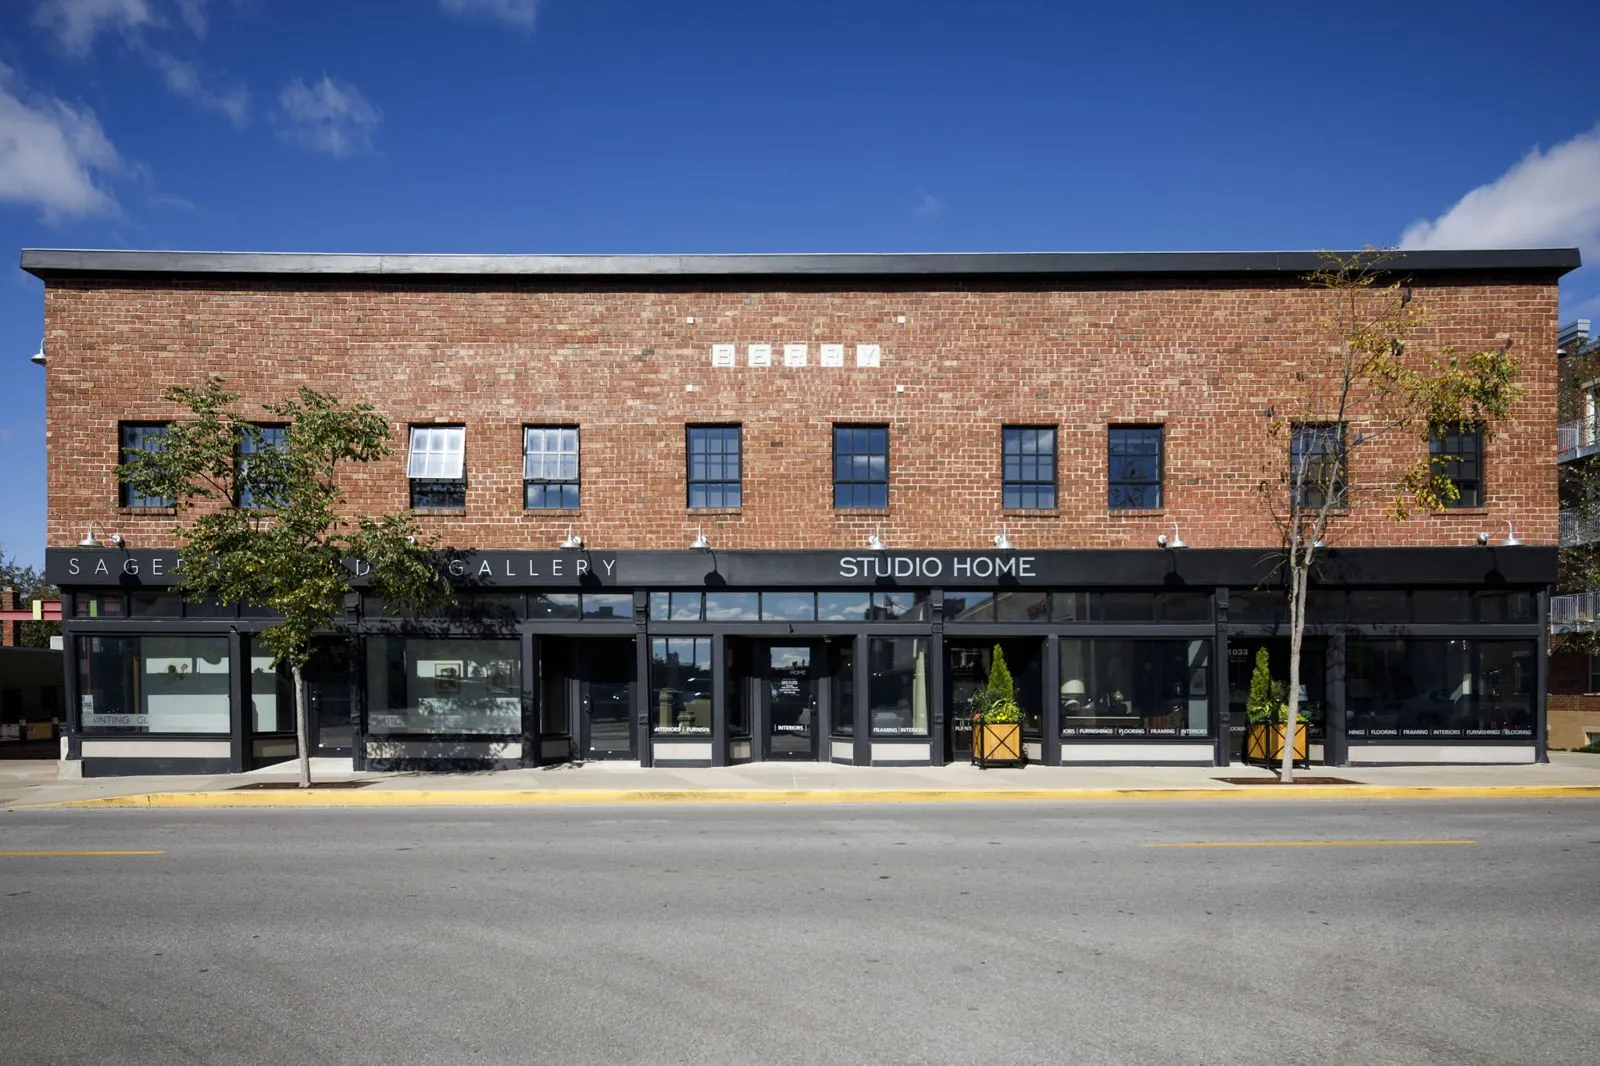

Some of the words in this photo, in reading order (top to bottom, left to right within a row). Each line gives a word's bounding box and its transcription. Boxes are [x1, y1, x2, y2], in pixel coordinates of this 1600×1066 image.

[68, 558, 186, 576] SAGE
[448, 559, 616, 577] GALLERY
[839, 556, 943, 577] STUDIO
[953, 557, 1036, 577] HOME
